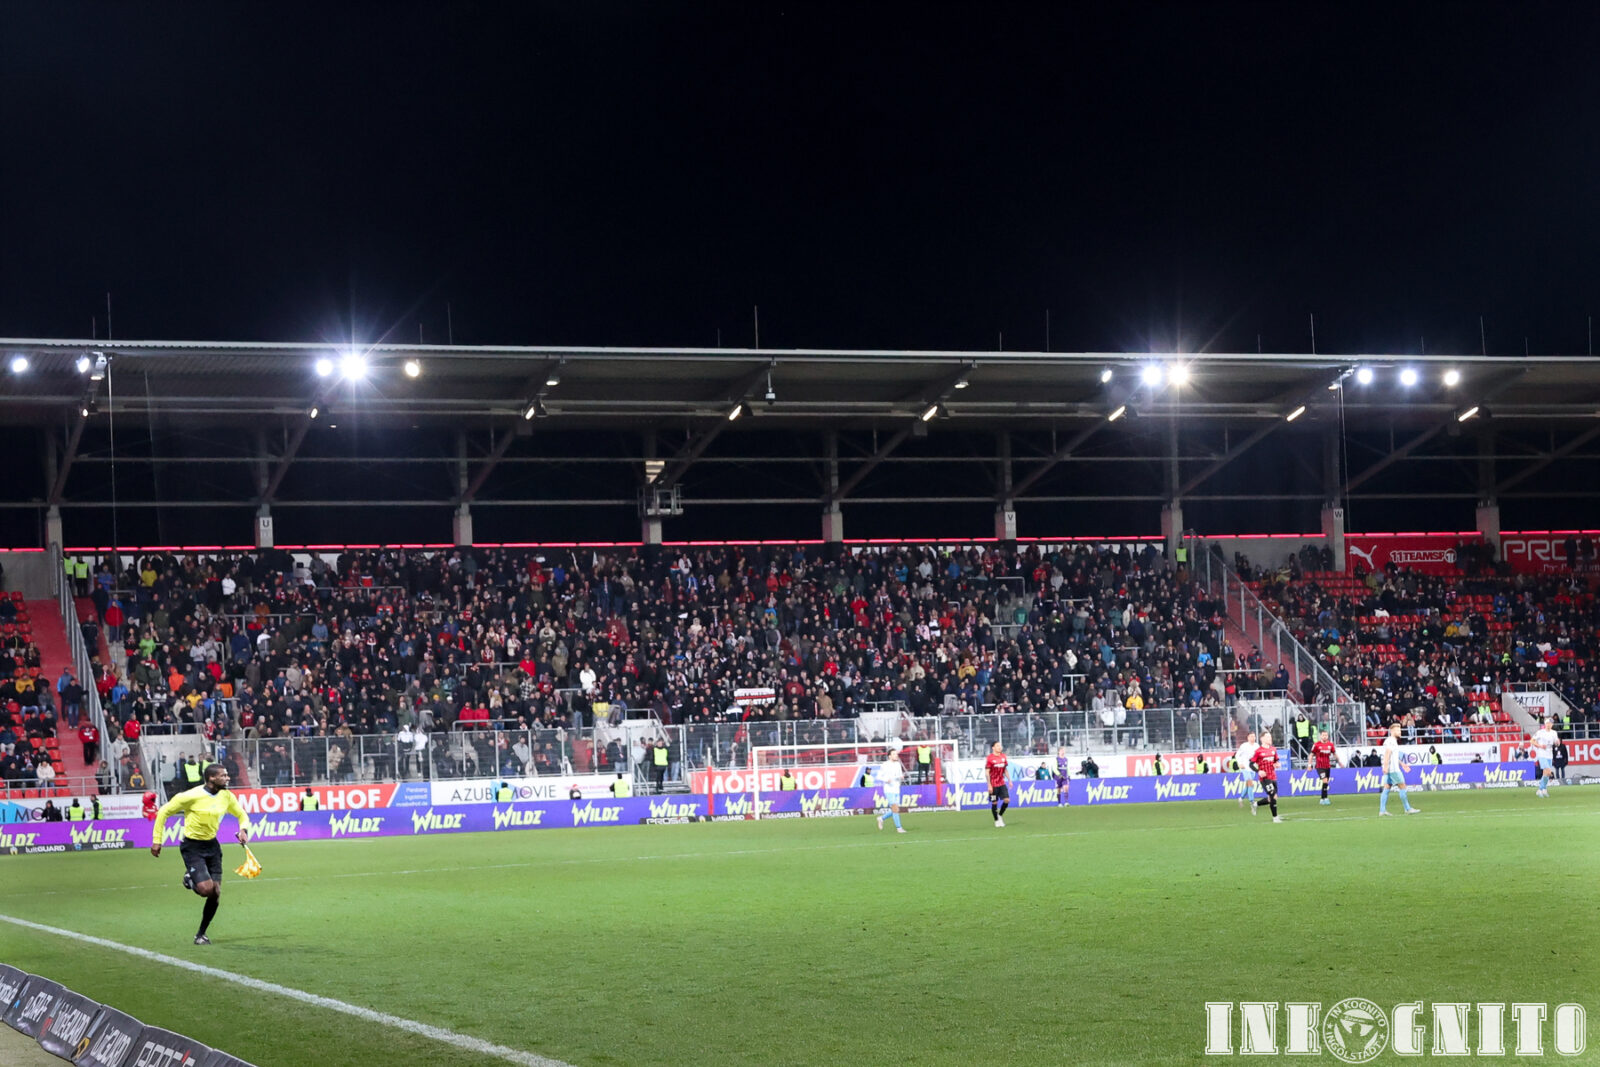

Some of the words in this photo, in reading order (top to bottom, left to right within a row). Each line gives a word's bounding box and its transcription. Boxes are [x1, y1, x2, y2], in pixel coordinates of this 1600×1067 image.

[262, 519, 270, 528] U
[1420, 766, 1460, 785] WILDZ
[1484, 764, 1523, 783] WILDZ
[1016, 782, 1058, 806] WILDZ
[1086, 779, 1129, 804] WILDZ
[1154, 776, 1198, 801] WILDZ
[492, 803, 542, 830] WILDZ
[571, 800, 620, 827] WILDZ
[649, 797, 697, 818] WILDZ
[329, 810, 381, 838] WILDZ
[411, 807, 463, 834] WILDZ
[69, 822, 126, 844] WILDZ
